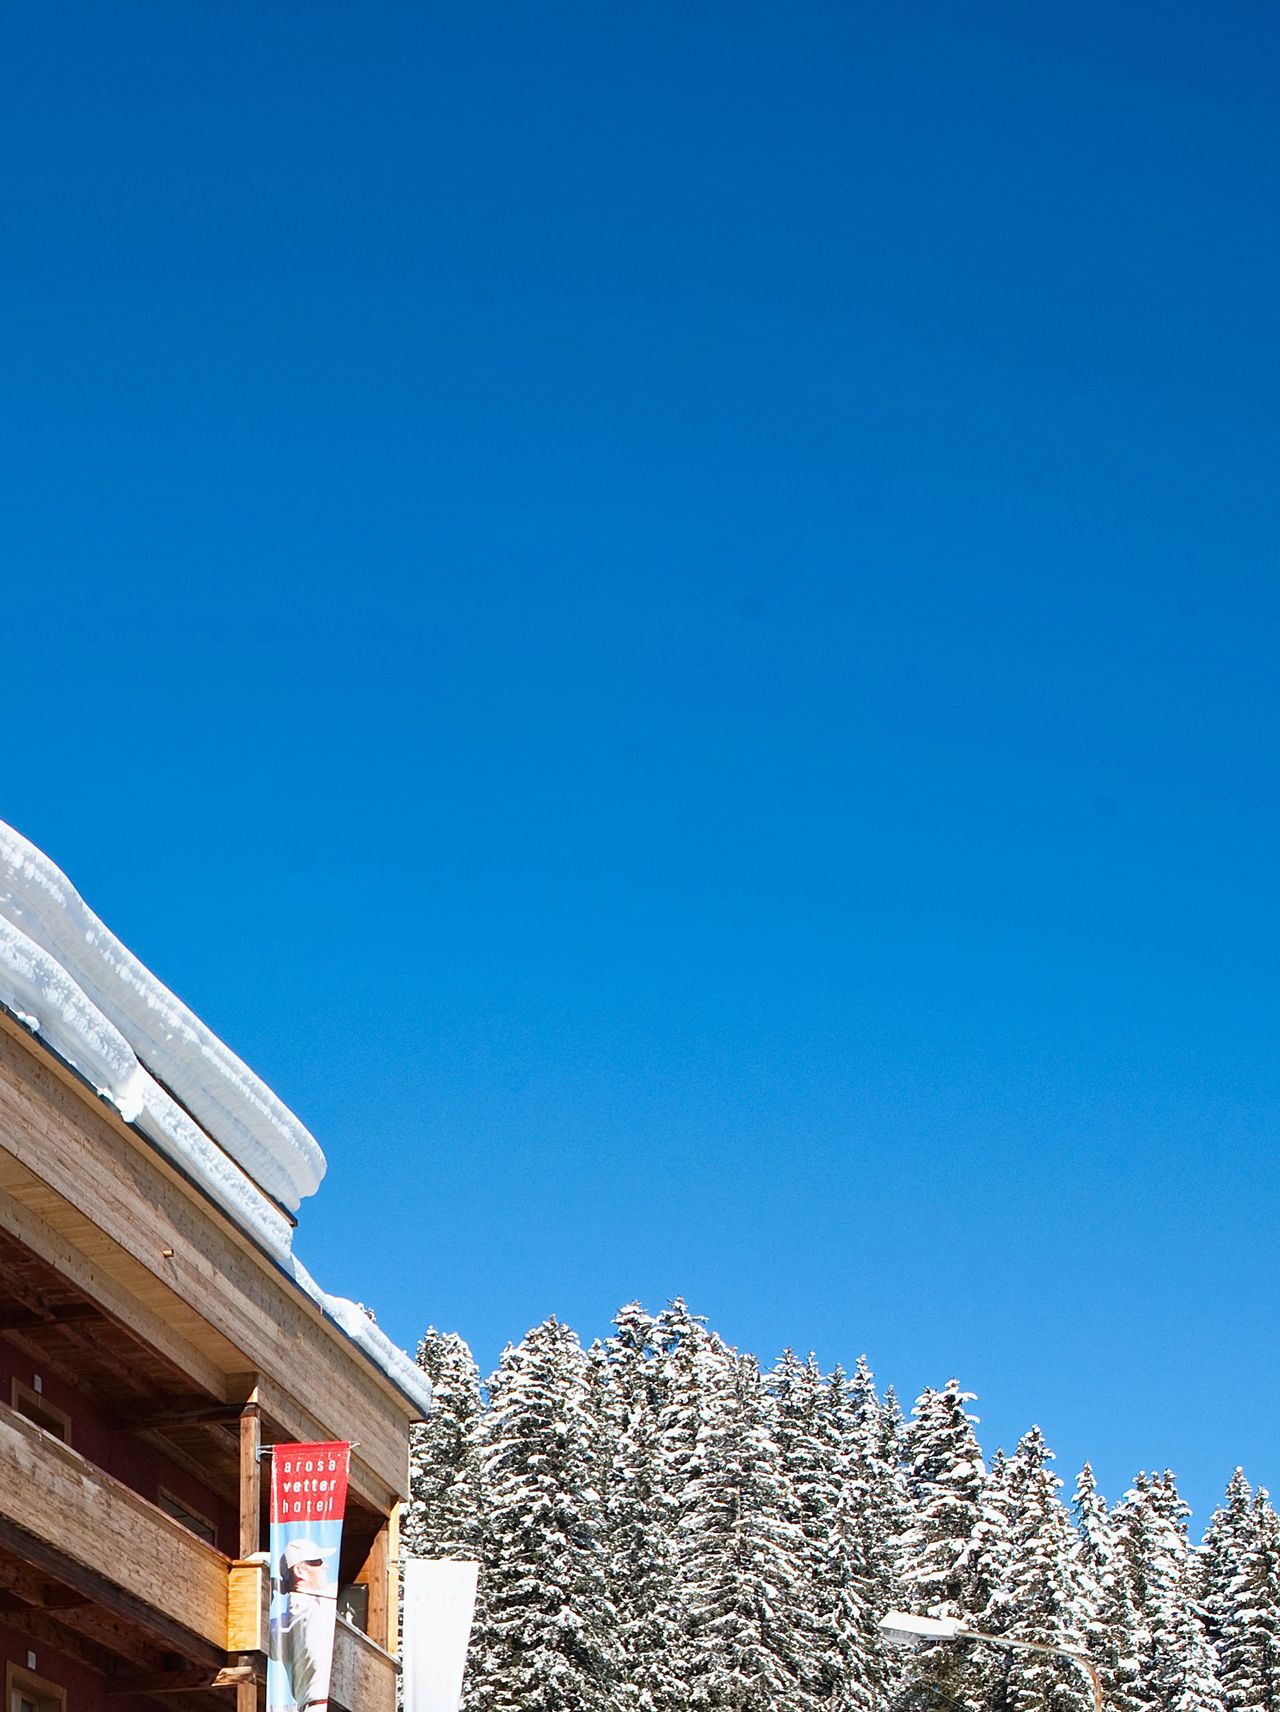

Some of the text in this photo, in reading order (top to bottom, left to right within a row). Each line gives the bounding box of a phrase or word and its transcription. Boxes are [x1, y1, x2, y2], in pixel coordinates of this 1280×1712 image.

[283, 1458, 337, 1474] arosa
[282, 1479, 337, 1494] vetter
[282, 1497, 334, 1515] hotel
